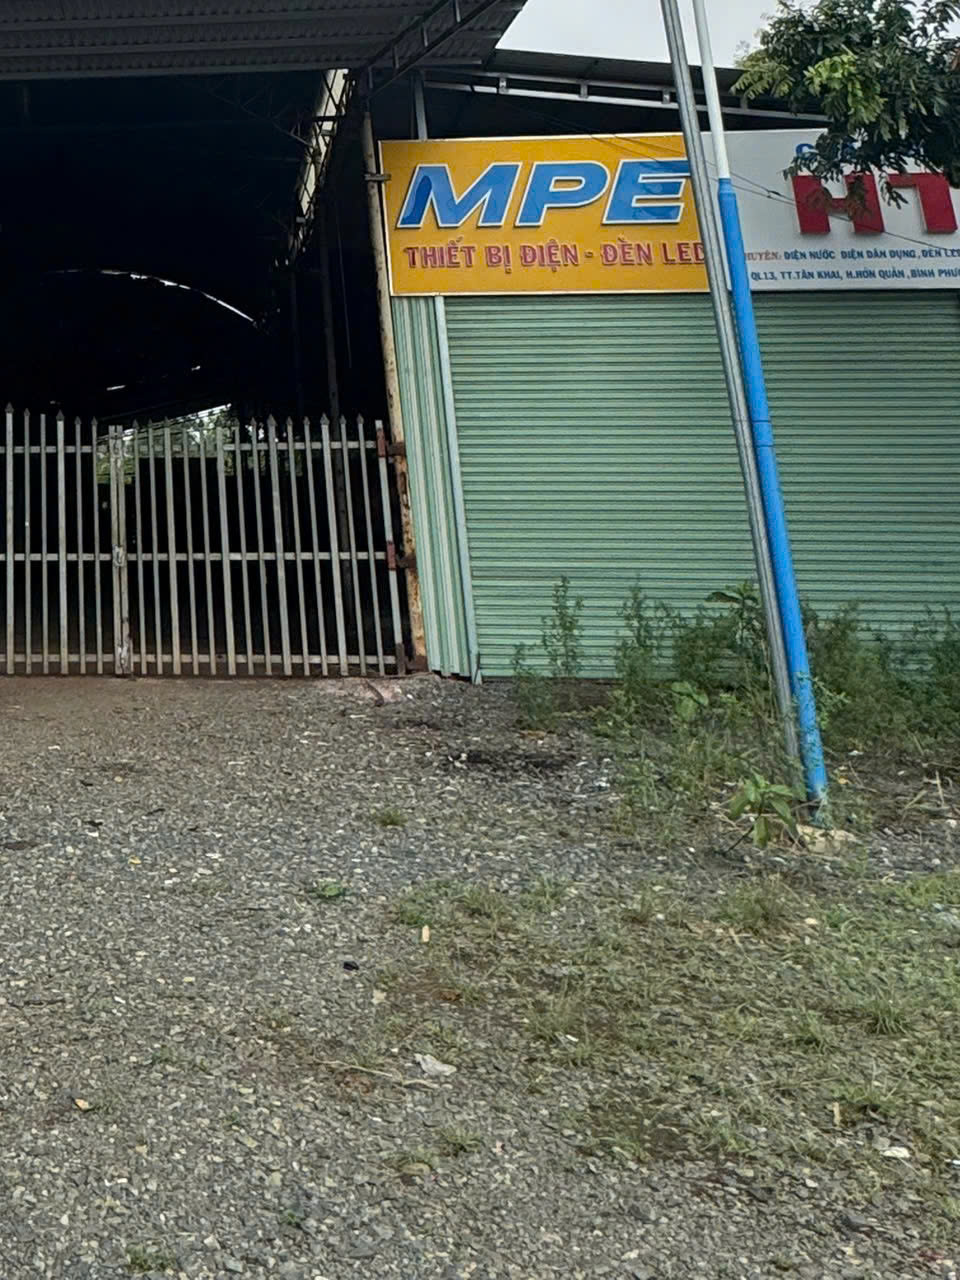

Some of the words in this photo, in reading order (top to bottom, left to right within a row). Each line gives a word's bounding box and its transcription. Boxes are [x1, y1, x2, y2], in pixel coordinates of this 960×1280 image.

[396, 157, 692, 229] MPE
[791, 172, 959, 234] HT
[404, 235, 477, 268] THIẾT
[485, 244, 512, 274] BỊ
[519, 238, 580, 273] ĐIỆN
[600, 236, 653, 267] ĐÈN
[662, 242, 705, 266] LED
